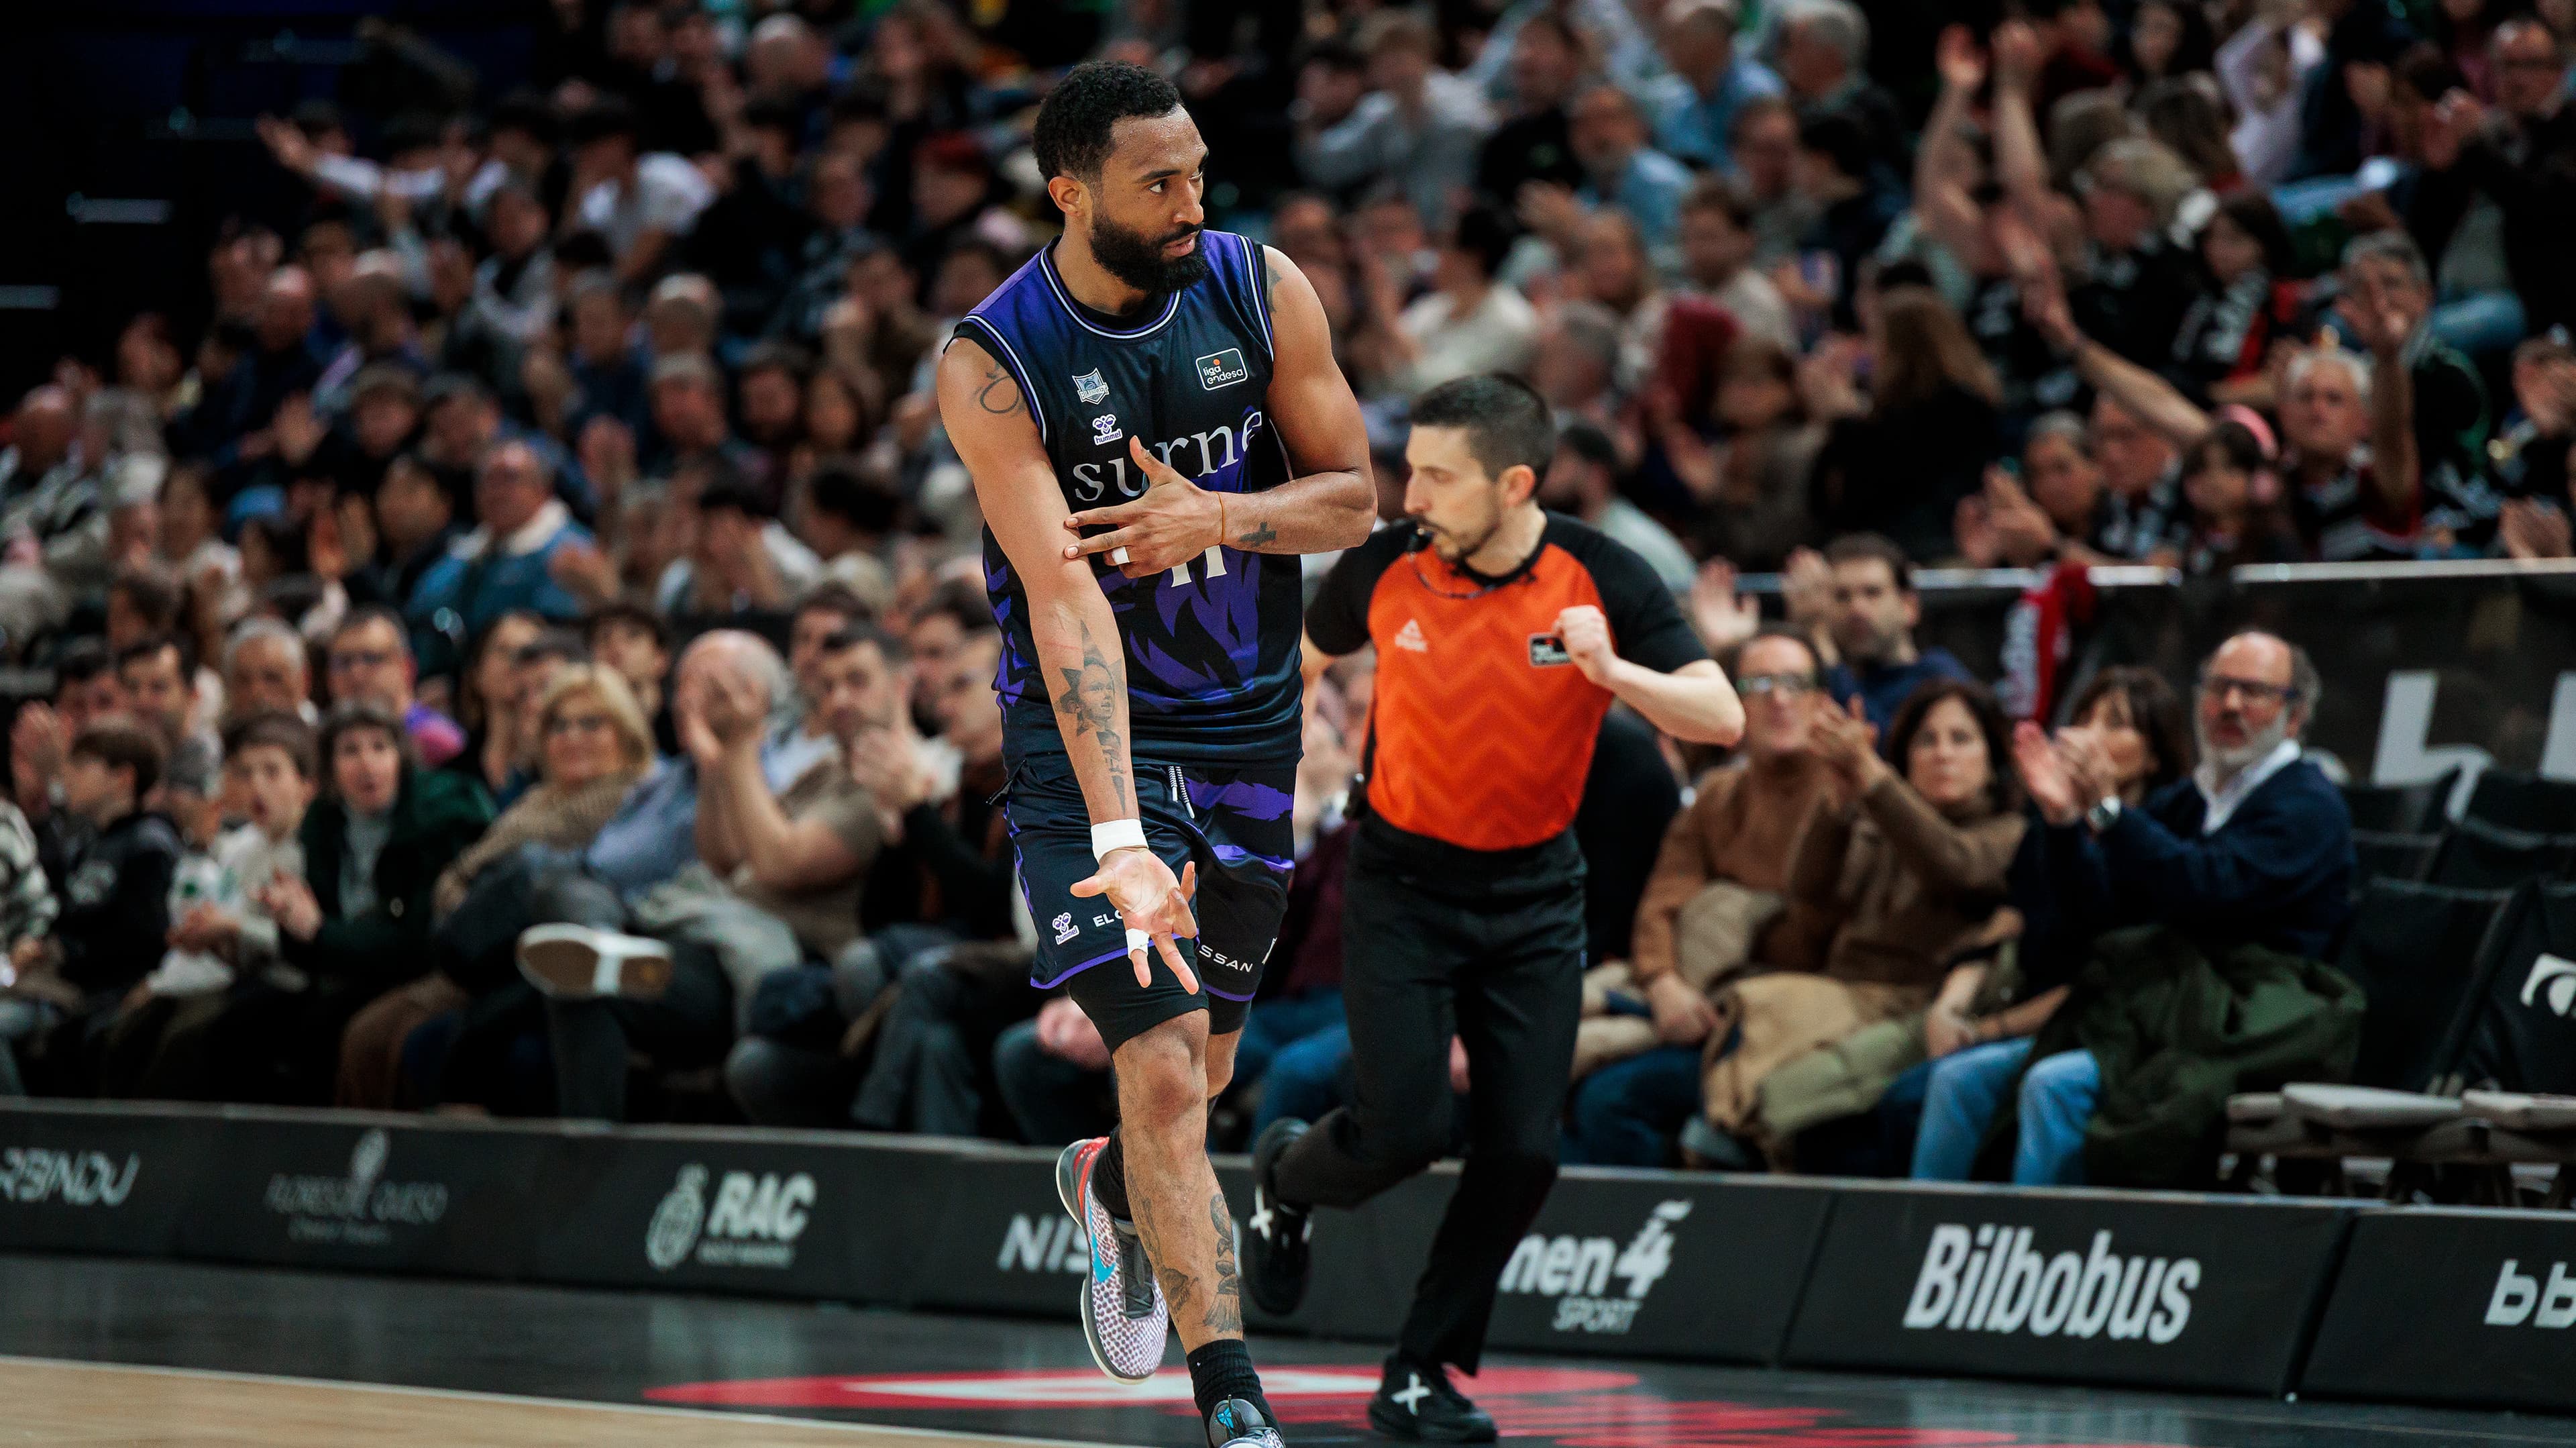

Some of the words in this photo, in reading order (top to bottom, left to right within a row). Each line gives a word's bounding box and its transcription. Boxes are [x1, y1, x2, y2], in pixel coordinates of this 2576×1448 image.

[1203, 366, 1221, 376] liga
[1207, 368, 1244, 384] endesa
[1095, 430, 1122, 444] hummel
[1057, 927, 1078, 943] hummel
[1199, 945, 1253, 972] SSAN
[708, 1172, 816, 1239] RAC
[1903, 1223, 2202, 1344] Bilbobus
[1552, 1297, 1642, 1334] SPORT
